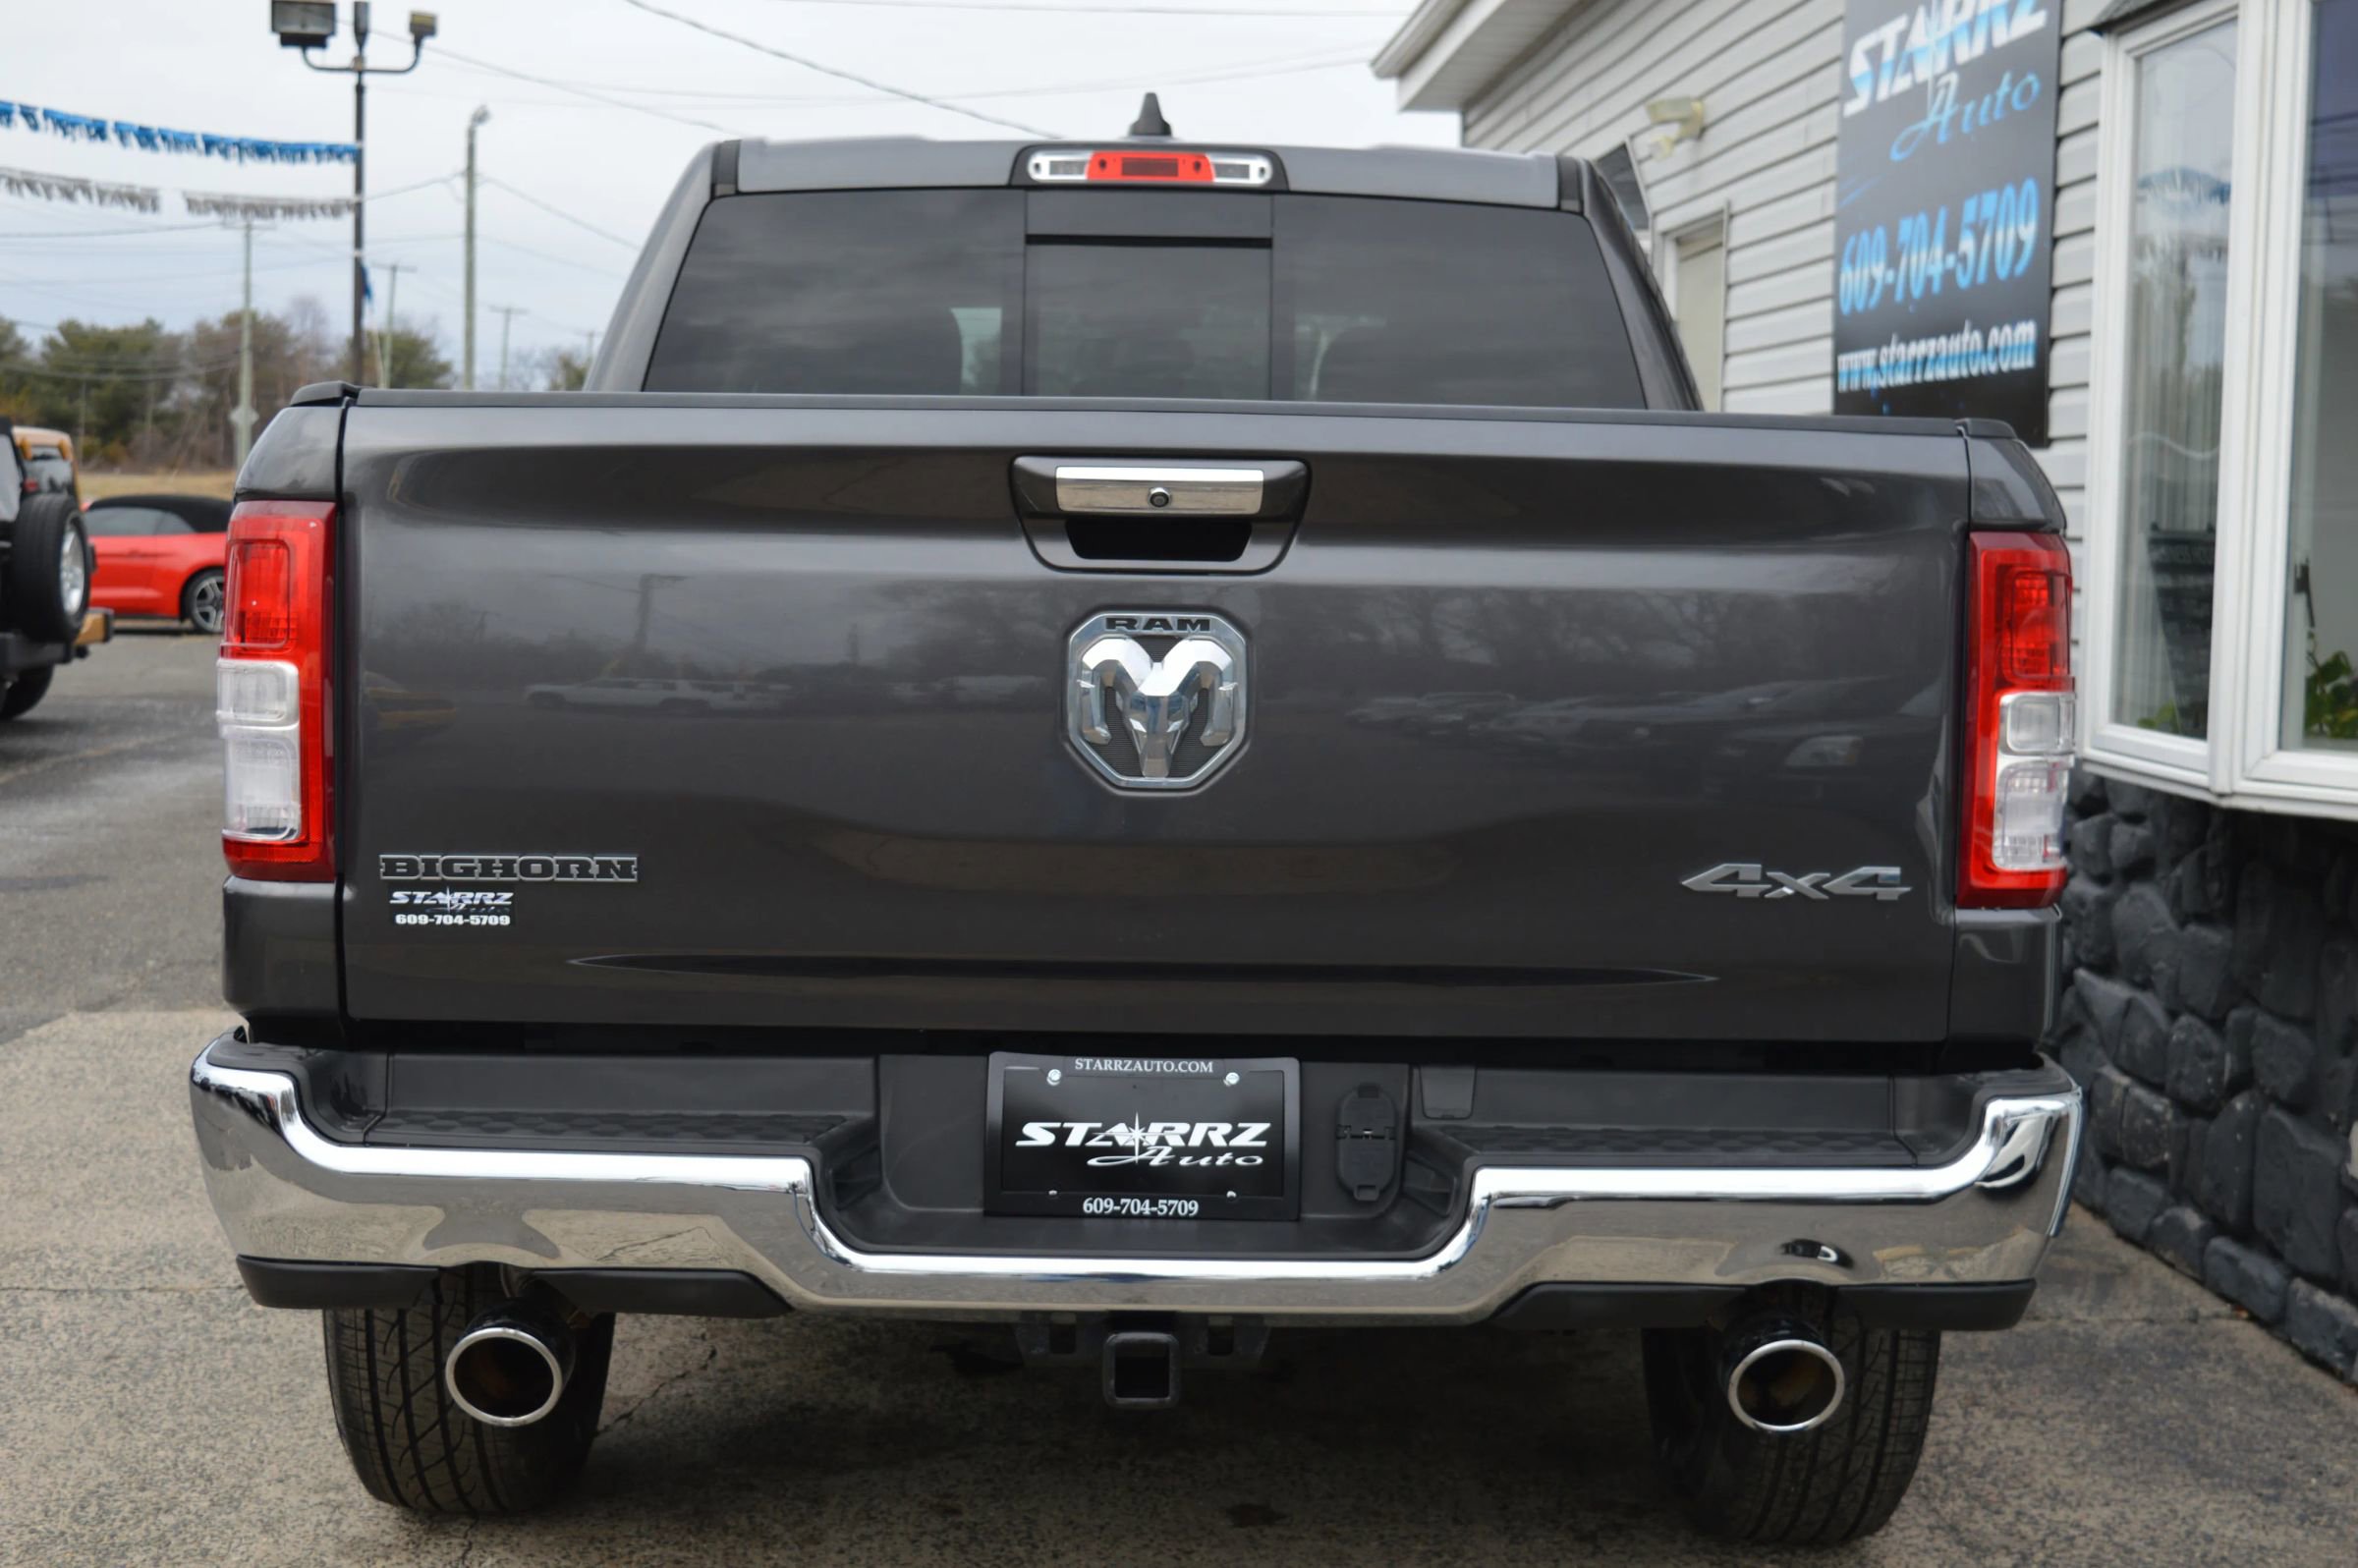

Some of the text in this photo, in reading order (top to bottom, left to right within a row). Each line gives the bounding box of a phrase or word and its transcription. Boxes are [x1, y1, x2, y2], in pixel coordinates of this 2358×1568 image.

[1889, 71, 2041, 162] Auto
[1838, 177, 2041, 316] 609-704-5709
[1837, 319, 2037, 393] www.starrzauto.com
[1105, 617, 1210, 632] RAM
[379, 854, 638, 881] BIGHORN
[389, 891, 514, 905] STARRZ
[395, 914, 511, 925] 609-704-5709
[1075, 1058, 1213, 1073] STARRZAUTO.COM
[1016, 1122, 1271, 1147] STARRZ
[1087, 1146, 1263, 1166] Auto
[1083, 1198, 1199, 1216] 609-704-5709
